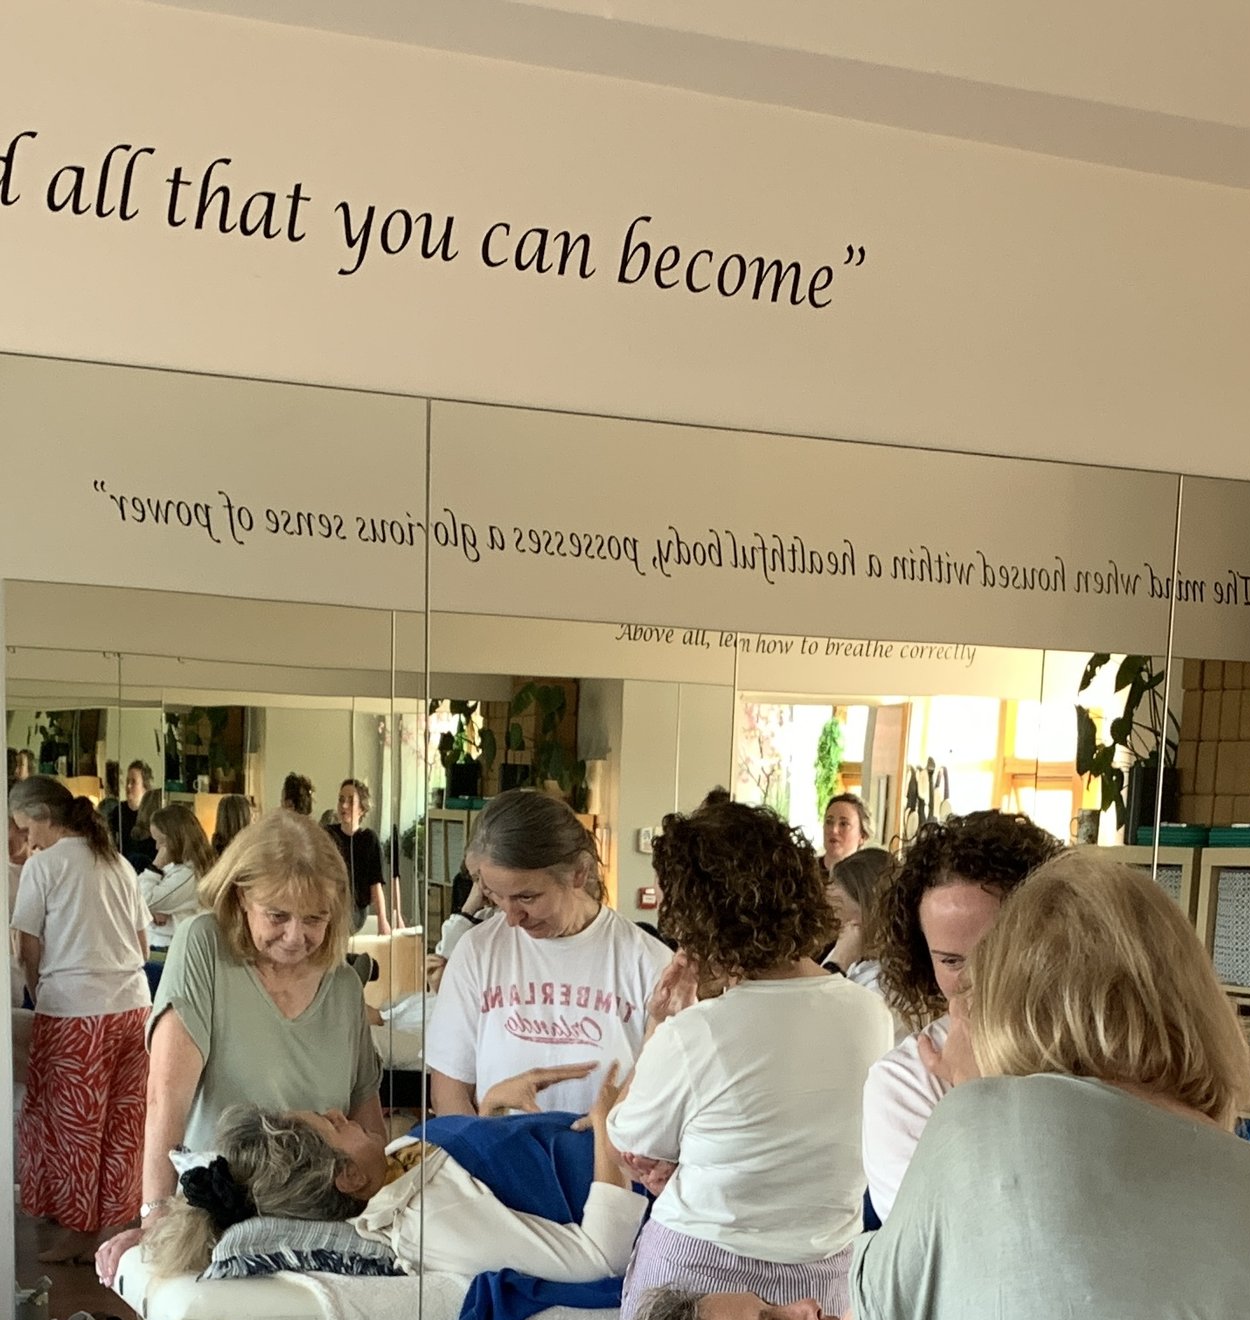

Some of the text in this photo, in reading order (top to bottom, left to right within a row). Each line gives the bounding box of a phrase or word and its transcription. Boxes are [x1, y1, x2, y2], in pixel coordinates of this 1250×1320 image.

[47, 144, 156, 221] all
[166, 158, 312, 242] that
[334, 201, 459, 276] you
[482, 222, 596, 279] can
[617, 216, 866, 309] become”
[756, 633, 794, 655] how
[801, 637, 818, 655] to
[825, 637, 893, 658] breathe
